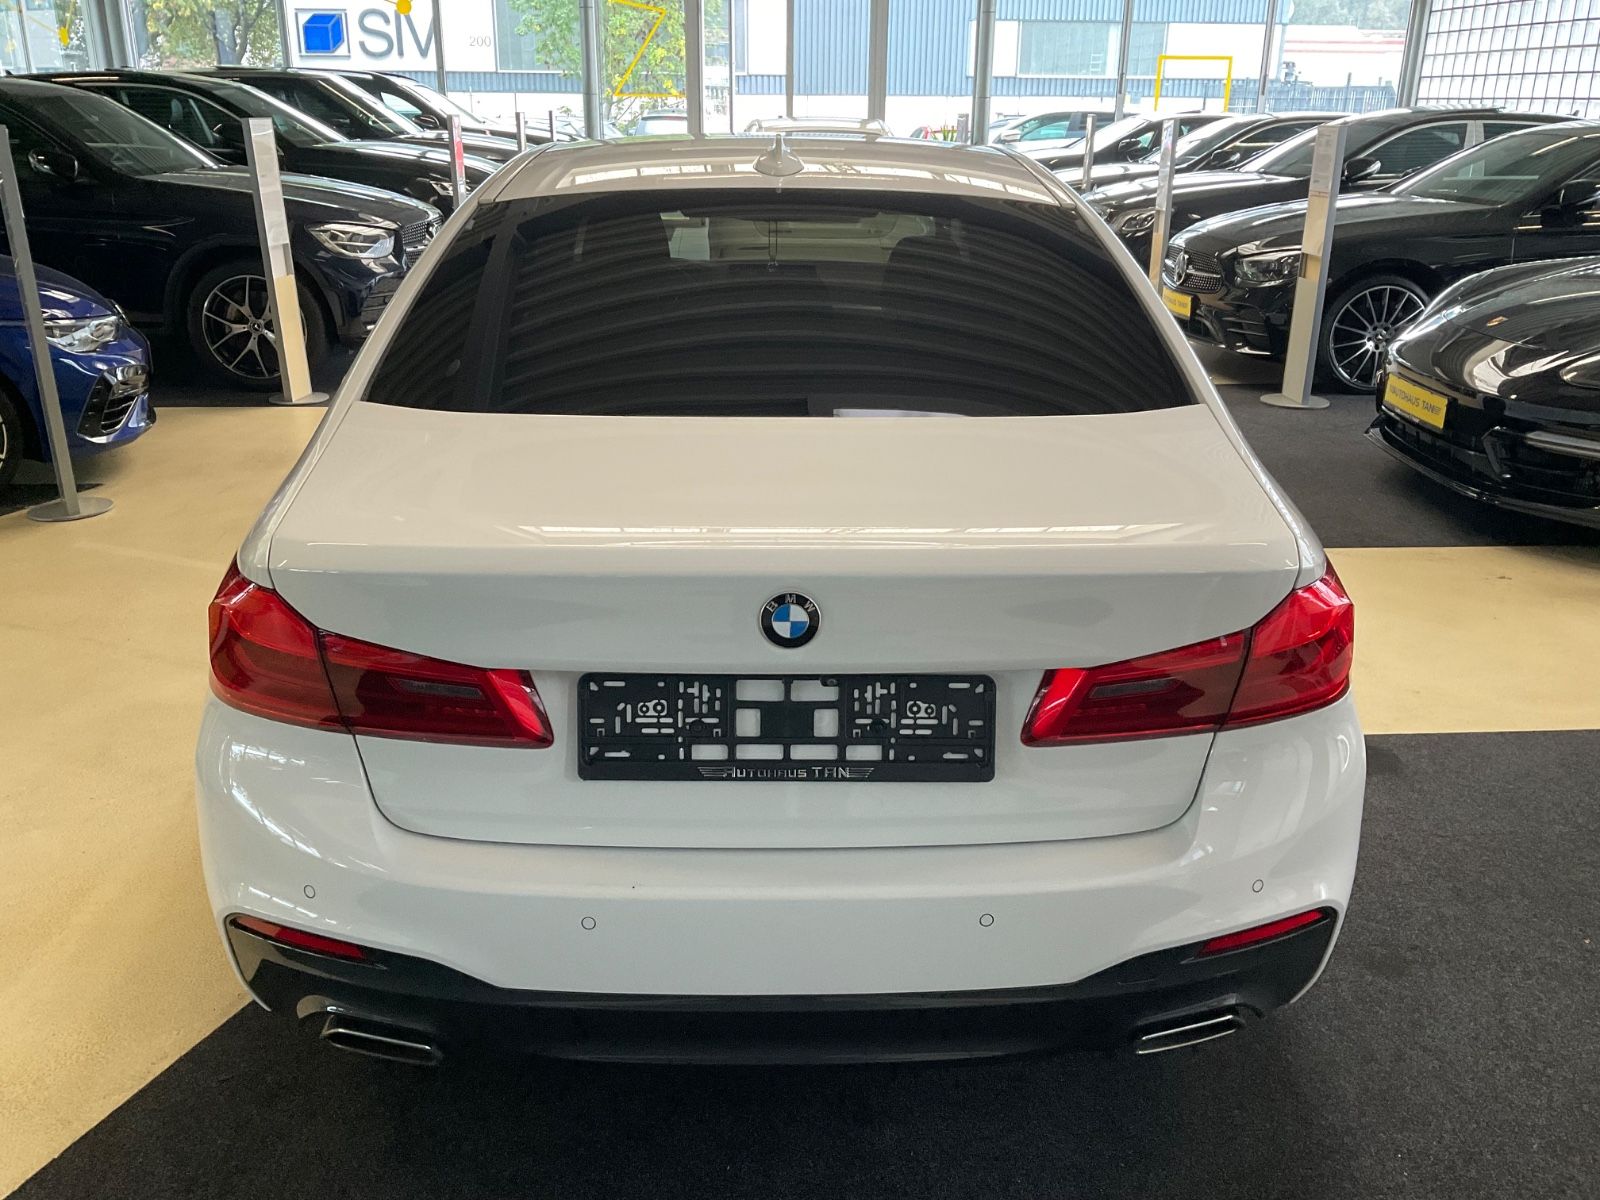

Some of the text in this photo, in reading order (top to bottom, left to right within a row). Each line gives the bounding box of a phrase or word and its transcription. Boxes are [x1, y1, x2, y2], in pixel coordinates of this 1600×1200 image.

[469, 35, 492, 48] 200
[766, 593, 816, 613] BMW
[811, 766, 850, 779] TAN
